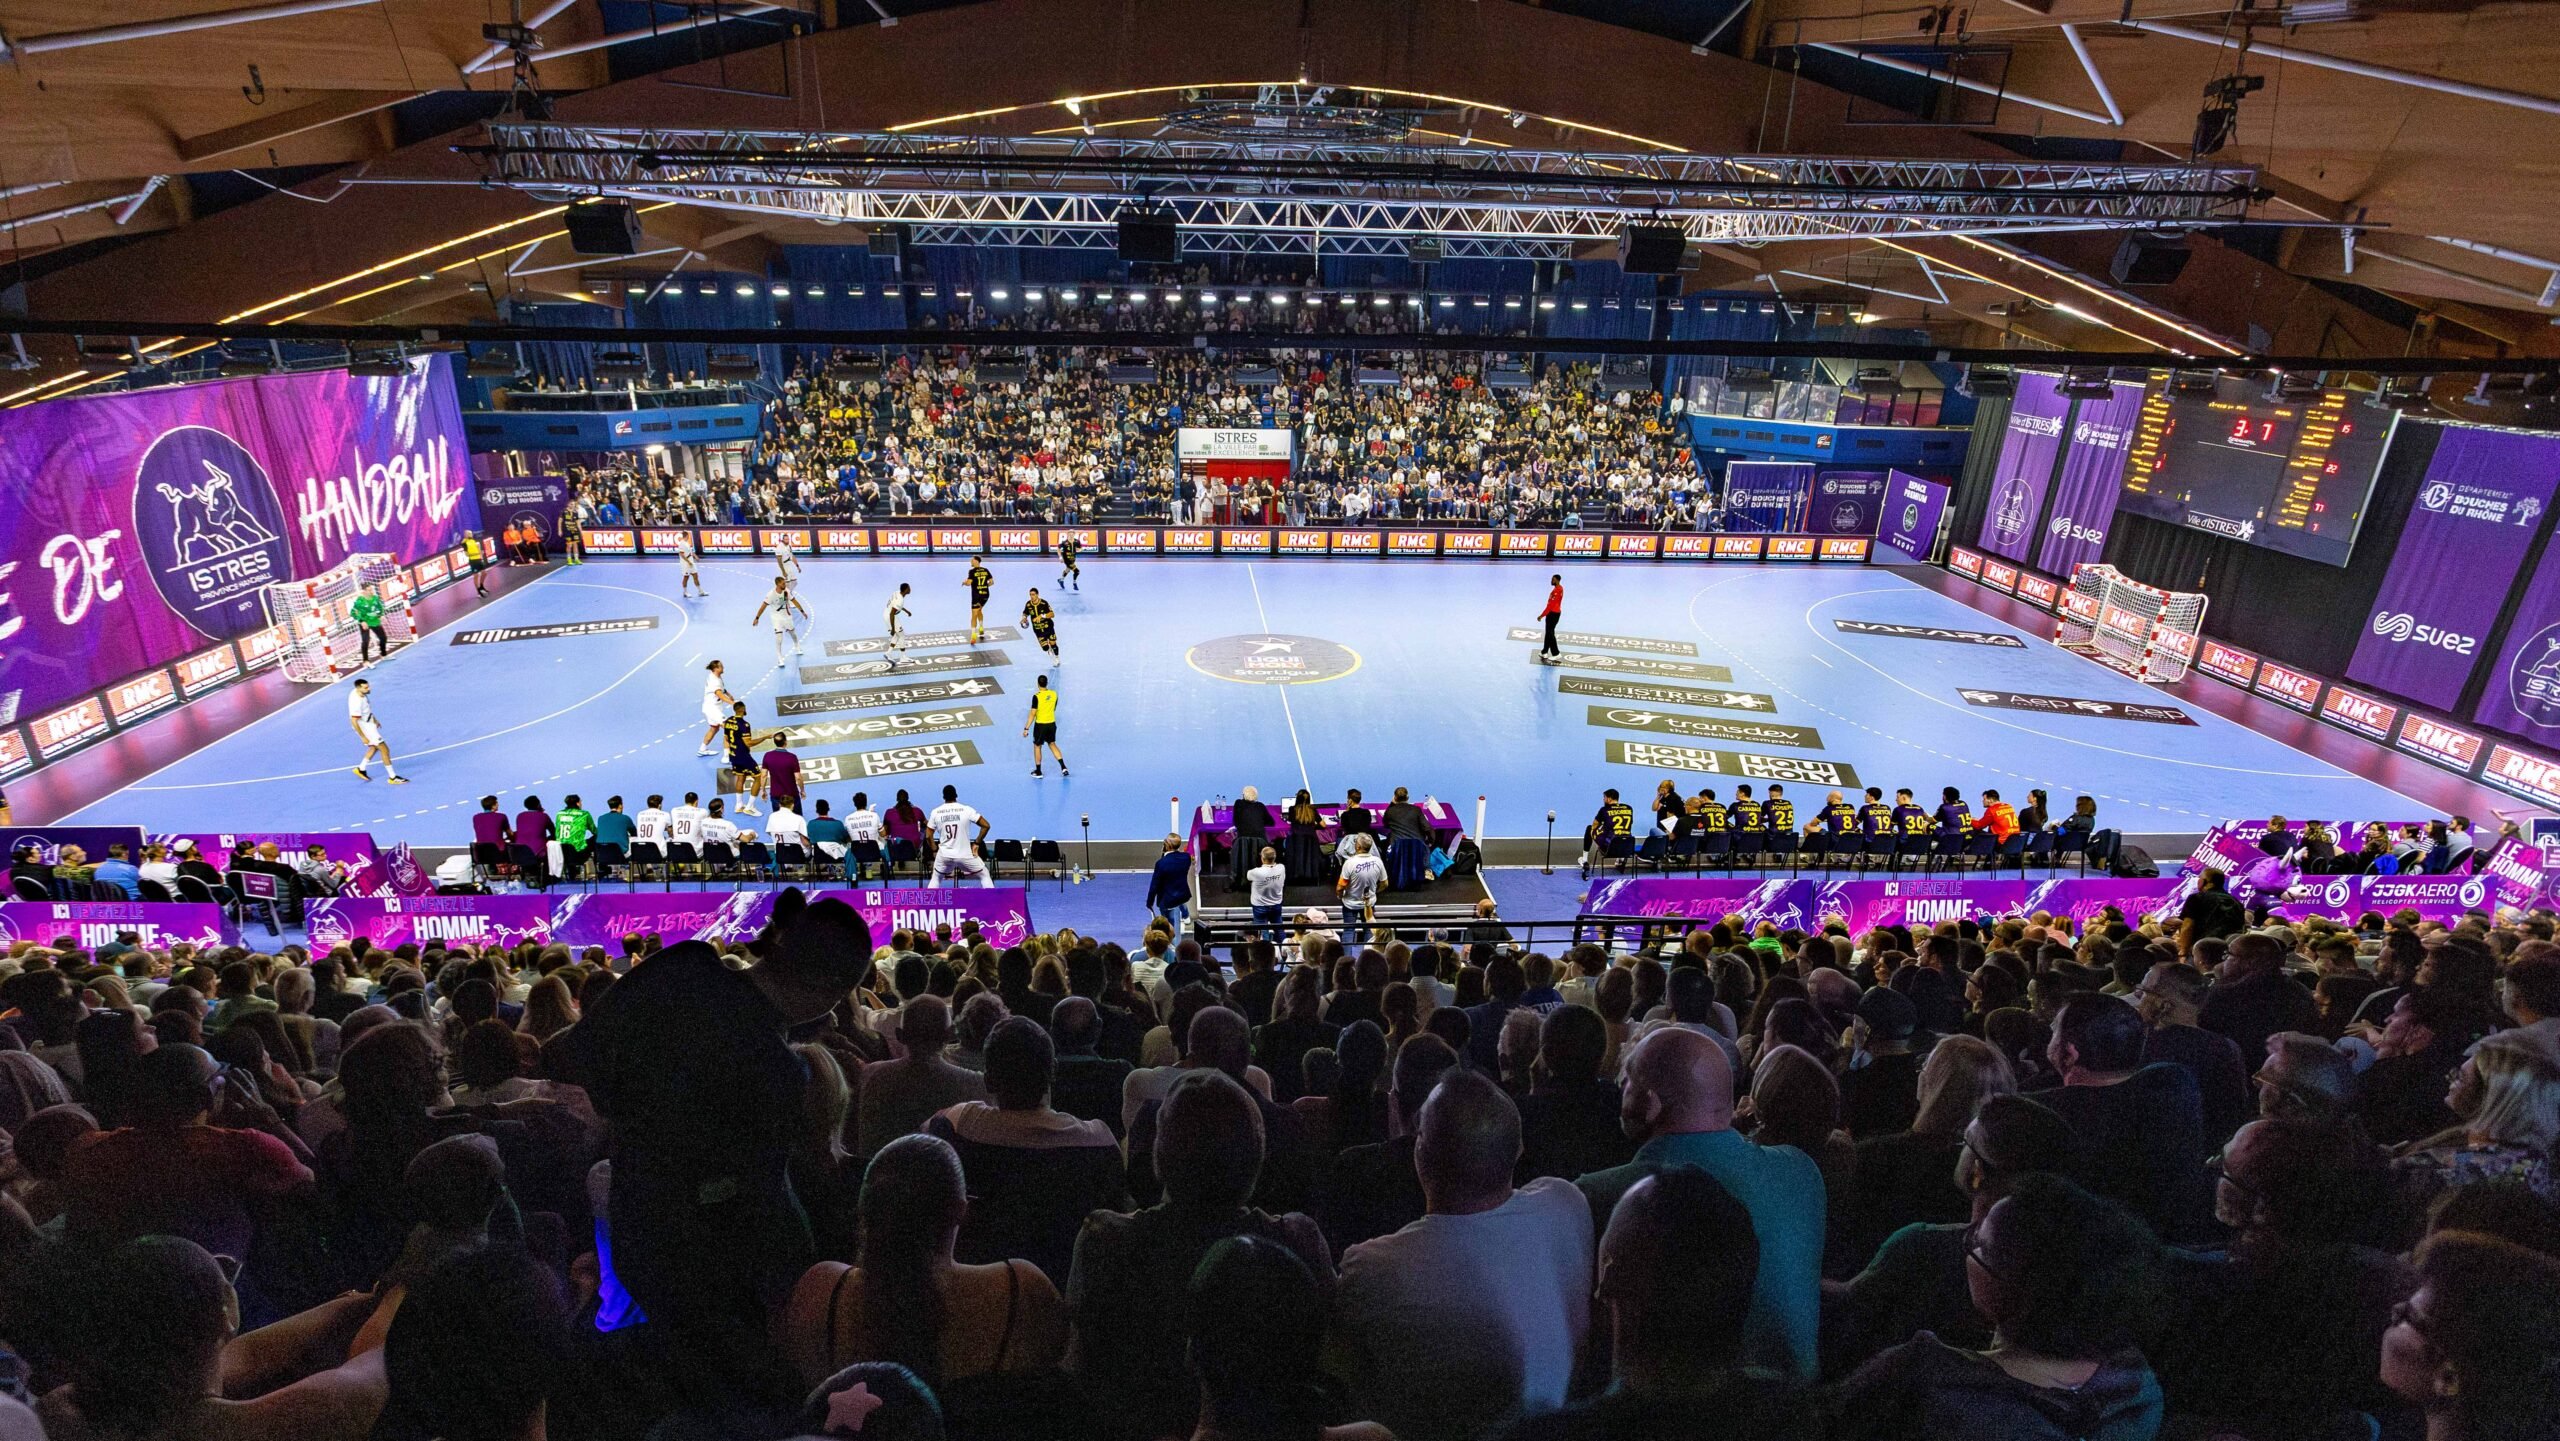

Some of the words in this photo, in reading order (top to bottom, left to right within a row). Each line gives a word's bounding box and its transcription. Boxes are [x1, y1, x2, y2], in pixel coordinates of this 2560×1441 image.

[1213, 432, 1258, 443] ISTRES
[299, 435, 464, 561] HANDBALL
[2454, 495, 2509, 512] BOUCHES
[2449, 504, 2463, 516] DU
[2187, 514, 2201, 526] Ville
[2201, 515, 2239, 536] d'ISTRES
[593, 532, 625, 546] RMC
[712, 532, 744, 545] RMC
[770, 532, 802, 545] RC
[829, 532, 860, 545] RMC
[888, 532, 919, 545] RMC
[942, 532, 973, 545] RMC
[1000, 532, 1031, 545] RMC
[1058, 532, 1089, 545] RC
[1116, 532, 1147, 545] RMC
[1174, 532, 1205, 545] RMC
[1231, 532, 1263, 545] RMC
[1288, 533, 1320, 546] RMC
[1341, 533, 1372, 546] RMC
[1398, 533, 1429, 547] RMC
[1454, 534, 1485, 548] RMC
[1509, 535, 1540, 549] RMC
[1564, 536, 1594, 550] RMC
[1619, 537, 1649, 550] RMC
[1673, 538, 1703, 551] RMC
[1724, 539, 1753, 552] RMC
[1778, 540, 1807, 553] RMC
[1830, 541, 1859, 554] RMC
[1956, 551, 1975, 569] RMC
[40, 529, 121, 625] DE
[187, 550, 271, 592] ISTRES
[1989, 566, 2009, 584] RMC
[2025, 579, 2049, 599] RMC
[2412, 623, 2476, 655] suez
[191, 652, 228, 680] RMC
[2270, 670, 2309, 696] RMC
[121, 678, 162, 707] RMC
[782, 699, 826, 711] Ville
[833, 686, 946, 707] d'ISTRES
[1565, 682, 1604, 693] Ville
[1609, 686, 1720, 703] d'ISTRES
[826, 697, 913, 711] www.istres.fr
[2336, 695, 2382, 723] RMC
[50, 703, 89, 741] RMC
[813, 708, 974, 736] weber
[886, 720, 983, 737] SAINT-GOBAIN
[1664, 717, 1800, 741] transdev
[1669, 727, 1690, 735] the
[1692, 730, 1742, 743] mobility
[1746, 735, 1801, 747] company
[2414, 723, 2466, 756] RMC
[867, 743, 951, 762] LIQUI
[1629, 743, 1711, 760] LIQUI
[869, 755, 956, 776] MOLY
[1631, 753, 1715, 771] MOLY
[1744, 754, 1831, 773] LIQUI
[1749, 766, 1836, 785] MOLY
[2502, 754, 2560, 791] RMC
[1612, 816, 1631, 830] 27
[1707, 813, 1725, 827] 13
[1748, 812, 1758, 826] 3
[1775, 811, 1793, 825] 25
[1843, 816, 1852, 830] 8
[1875, 816, 1891, 830] 19
[1905, 816, 1924, 830] 30
[1958, 813, 1971, 827] 15
[560, 824, 571, 839] 16
[640, 824, 654, 839] 90
[677, 820, 691, 835] 20
[944, 824, 958, 840] 97
[219, 834, 236, 848] ICI
[858, 830, 869, 841] 19
[2201, 829, 2223, 848] LE
[2498, 839, 2523, 859] LE
[2191, 843, 2240, 876] HOMME
[1885, 882, 1899, 896] ICI
[2371, 883, 2459, 897] JJGKAERO
[385, 897, 402, 912] ICI
[866, 891, 882, 905] ICI
[883, 890, 936, 905] DEVENEZ
[938, 890, 953, 905] LE
[53, 903, 70, 919] ICI
[1906, 899, 1974, 922] HOMME
[413, 916, 490, 941] HOMME
[892, 909, 967, 933] HOMME
